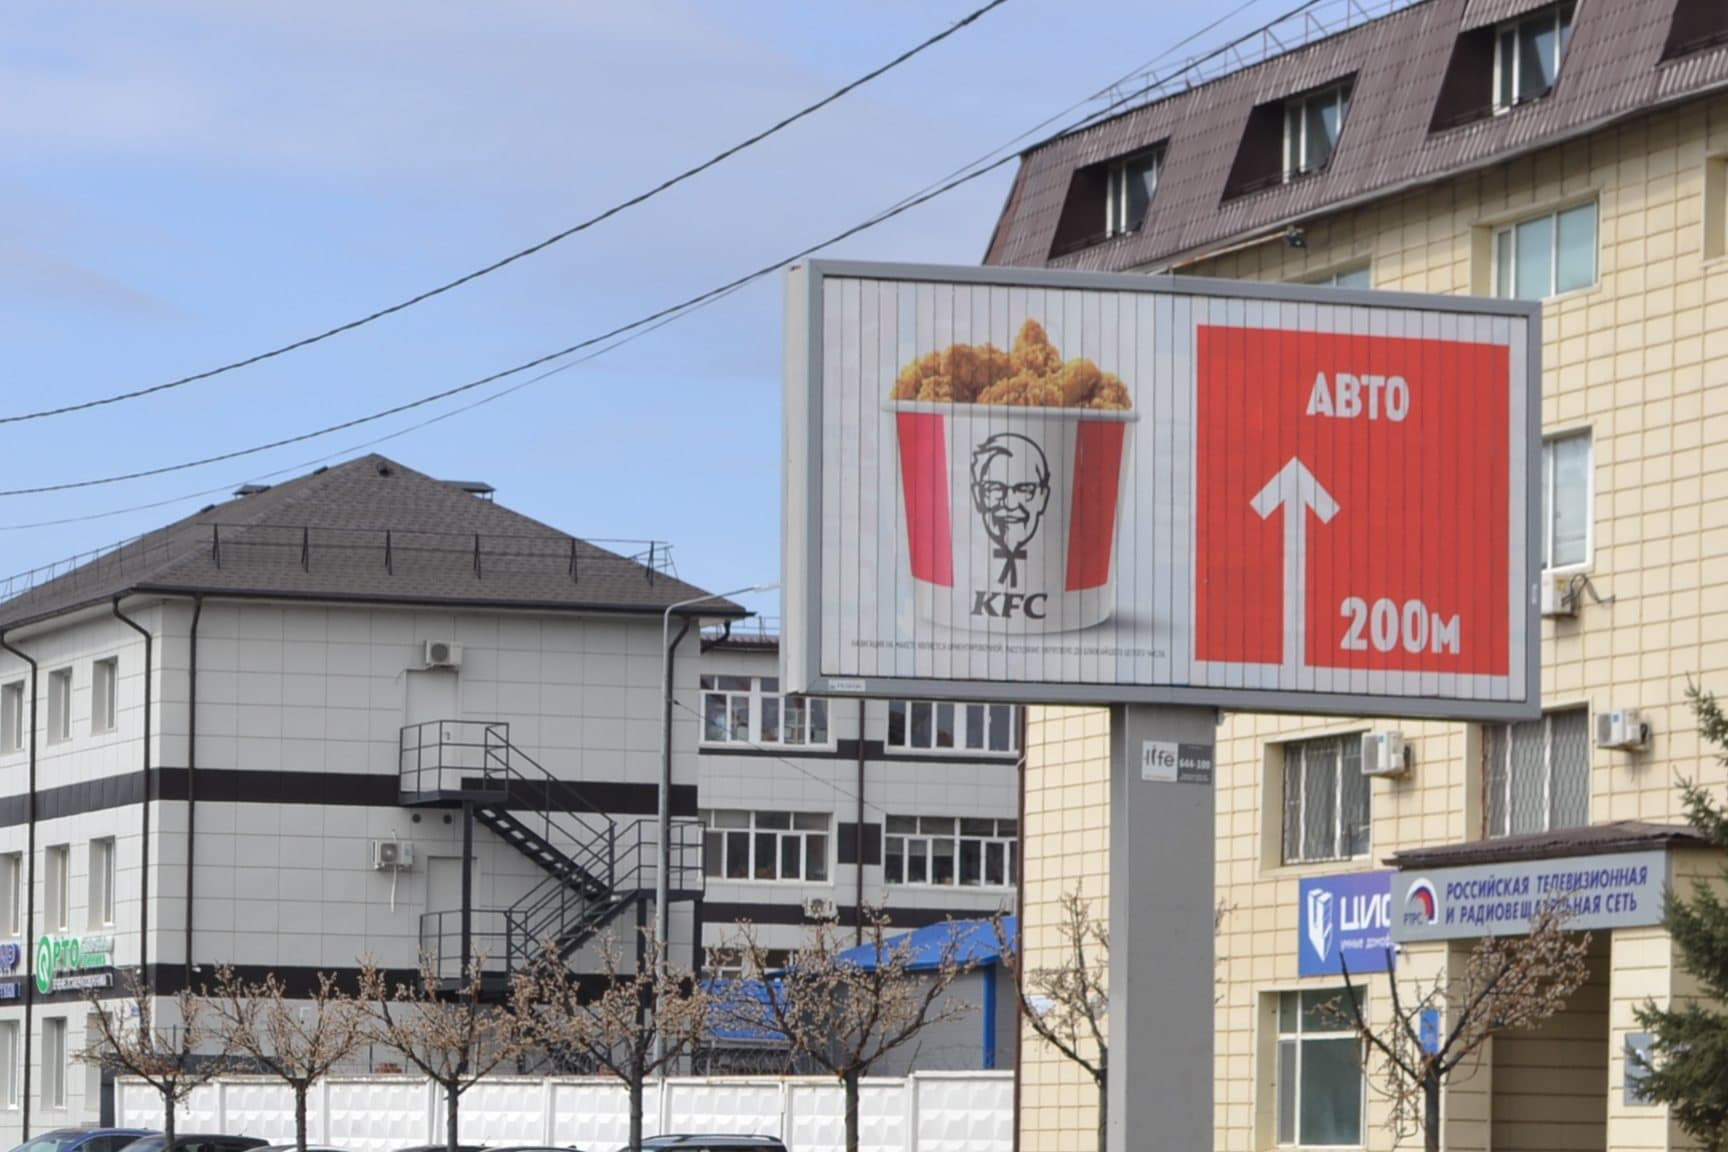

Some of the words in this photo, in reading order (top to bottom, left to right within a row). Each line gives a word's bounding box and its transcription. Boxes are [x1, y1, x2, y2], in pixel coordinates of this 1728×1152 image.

[1306, 371, 1410, 422] АВТО
[970, 590, 1048, 620] KFC
[1446, 875, 1530, 900] РОССИЙСКАЯ
[1537, 865, 1647, 893] ТЕЛЕВИЗИОННАЯ
[1446, 907, 1455, 924] И
[1460, 895, 1601, 926] РАДИОВЕЩАЛЬНАЯ
[1605, 892, 1637, 913] СЕТЬ
